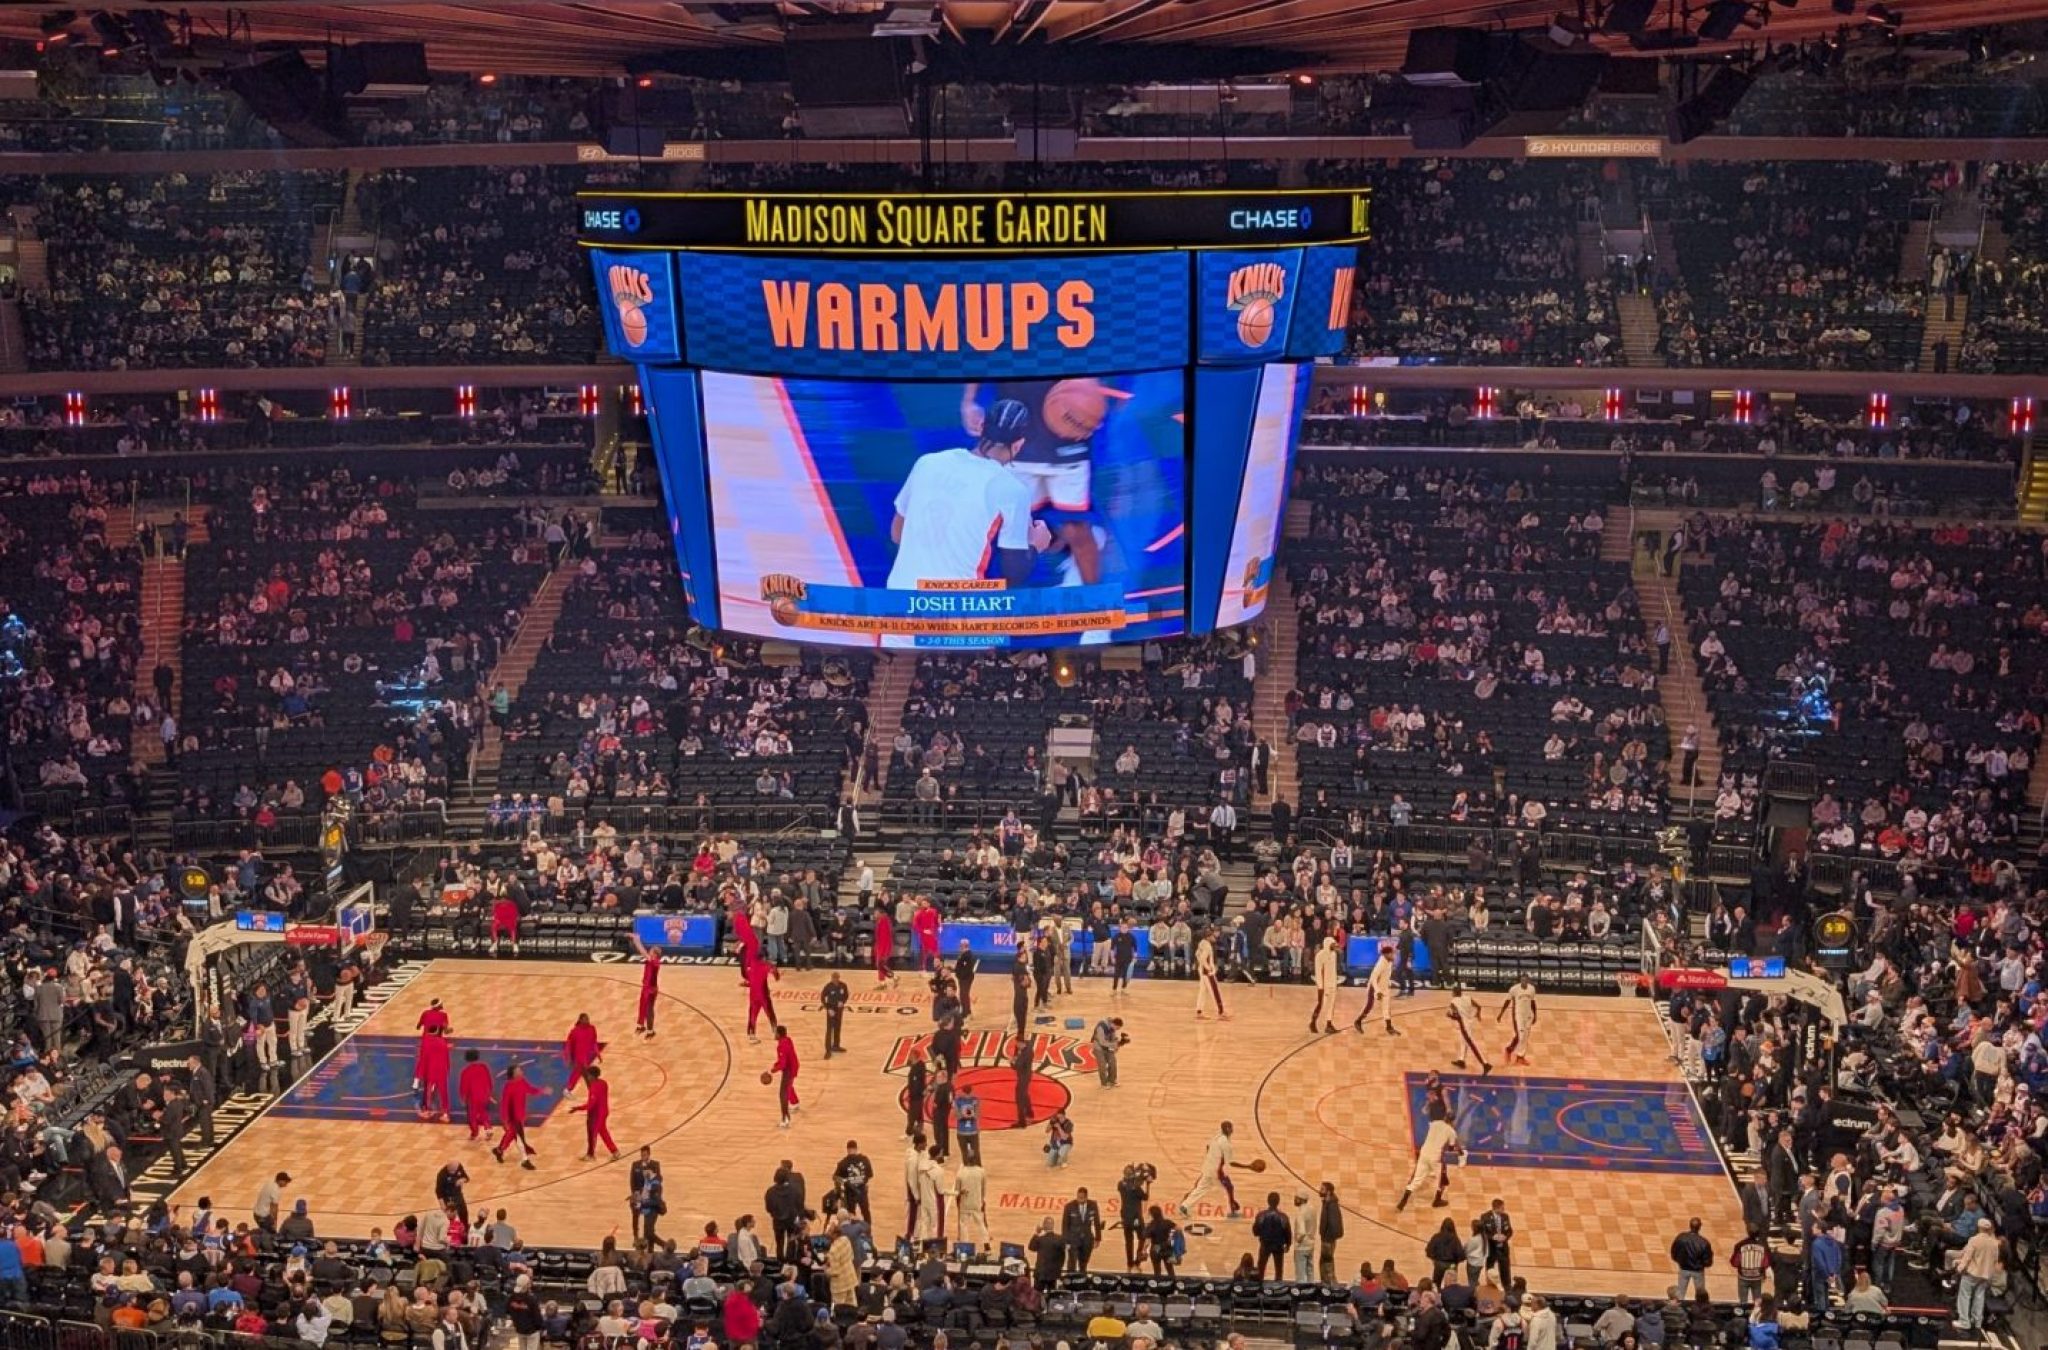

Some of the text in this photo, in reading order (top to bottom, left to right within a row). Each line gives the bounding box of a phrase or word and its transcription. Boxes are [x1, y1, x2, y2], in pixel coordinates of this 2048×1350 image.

[1552, 142, 1659, 153] HYUNDAI BRIDGE
[584, 210, 621, 228] CHASE
[746, 199, 1107, 246] MADISON SQUARE GARDEN
[1230, 209, 1298, 229] CHASE
[1227, 263, 1286, 306] KNICKS
[762, 279, 1095, 351] WARMUPS
[761, 574, 806, 599] KNICKS
[924, 579, 1000, 590] KNICKS CAREER
[907, 596, 1016, 614] JOSH HART
[820, 617, 855, 628] KNICKS
[857, 620, 875, 628] ARE
[927, 622, 958, 631] WHEN
[961, 622, 988, 631] HART
[992, 620, 1039, 631] RECORDS
[1057, 616, 1111, 628] REBOUNDS
[943, 636, 965, 645] THIS
[967, 636, 1005, 645] SEASON
[1805, 1024, 1816, 1060] ectrum
[151, 1058, 188, 1070] Spectru
[1833, 1118, 1872, 1130] ectrum
